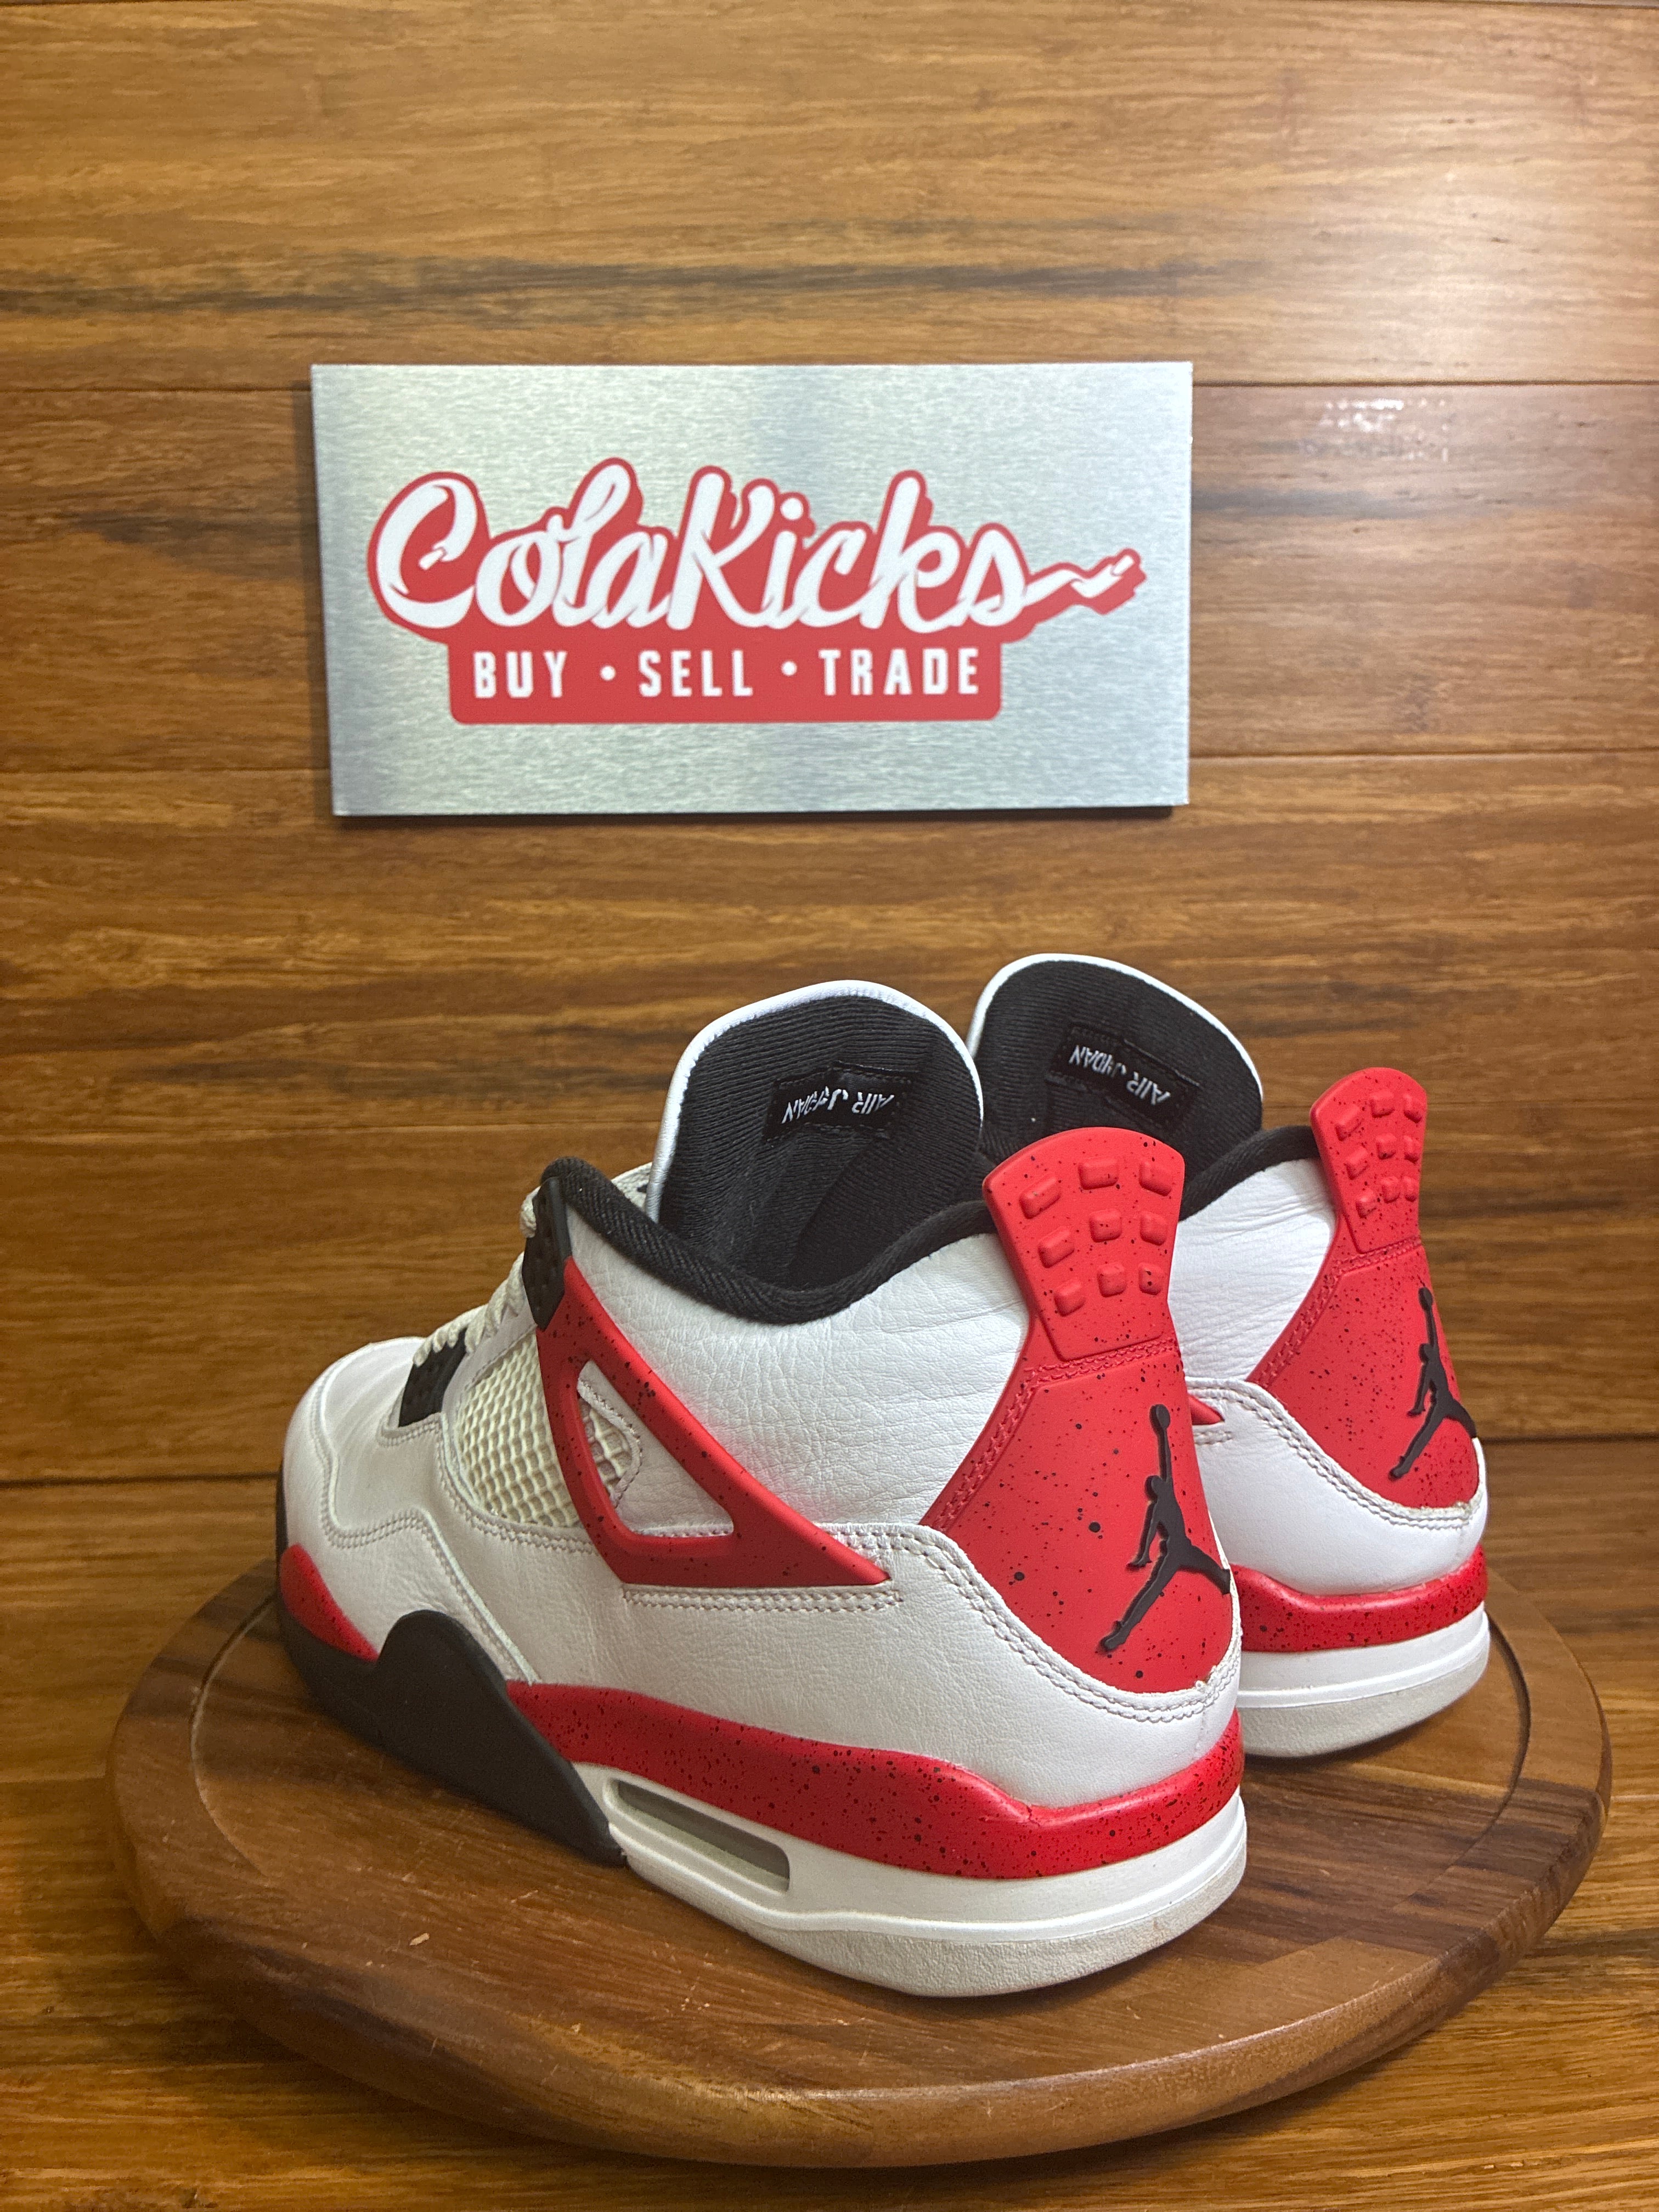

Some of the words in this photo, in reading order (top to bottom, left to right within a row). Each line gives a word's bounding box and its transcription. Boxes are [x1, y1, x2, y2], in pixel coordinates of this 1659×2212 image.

[375, 464, 1136, 634] ColaKicks
[473, 651, 567, 698] BUY
[639, 650, 753, 697] SELL
[818, 647, 979, 696] TRADE
[851, 1092, 895, 1114] AIR
[1126, 1071, 1171, 1105] AIR
